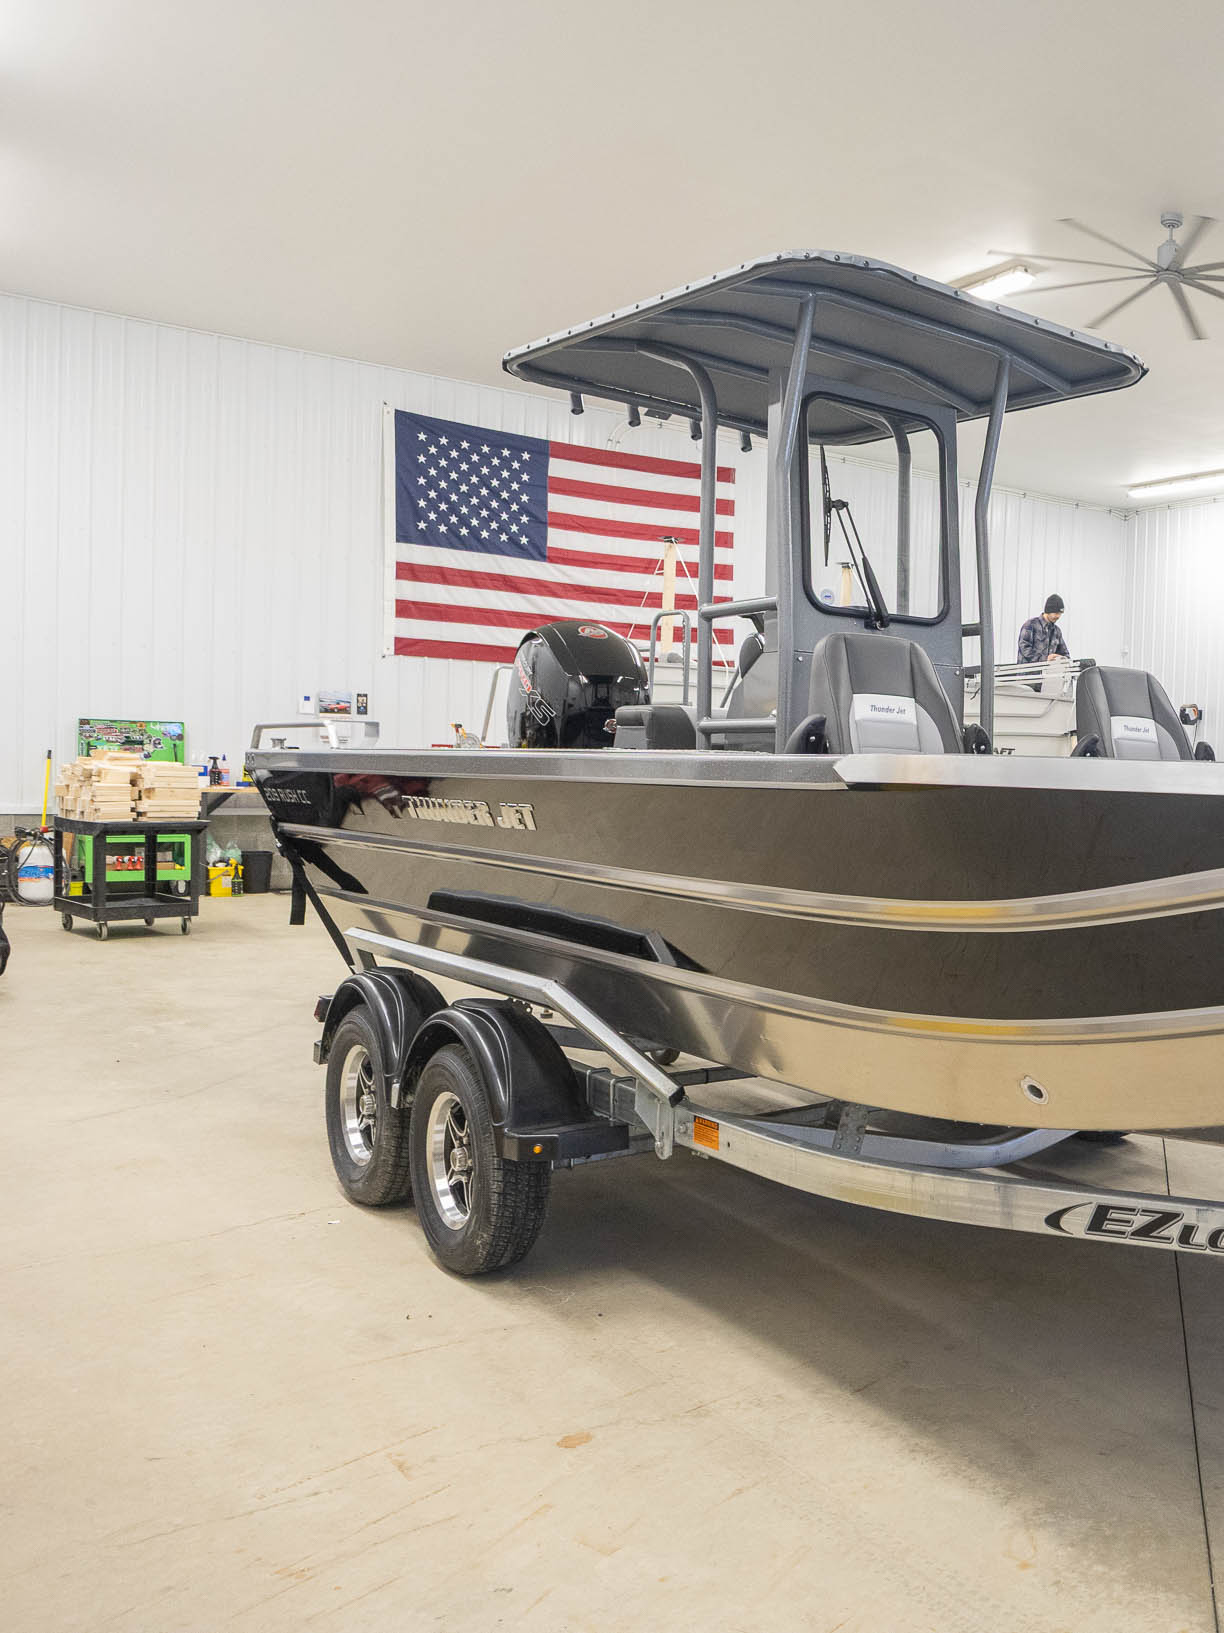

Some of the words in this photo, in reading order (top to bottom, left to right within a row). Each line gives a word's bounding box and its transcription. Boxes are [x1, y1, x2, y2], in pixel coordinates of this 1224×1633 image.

[870, 704, 895, 714] Thunder
[896, 706, 906, 715] Jet
[401, 795, 495, 827] THUNDER
[496, 802, 538, 831] JET
